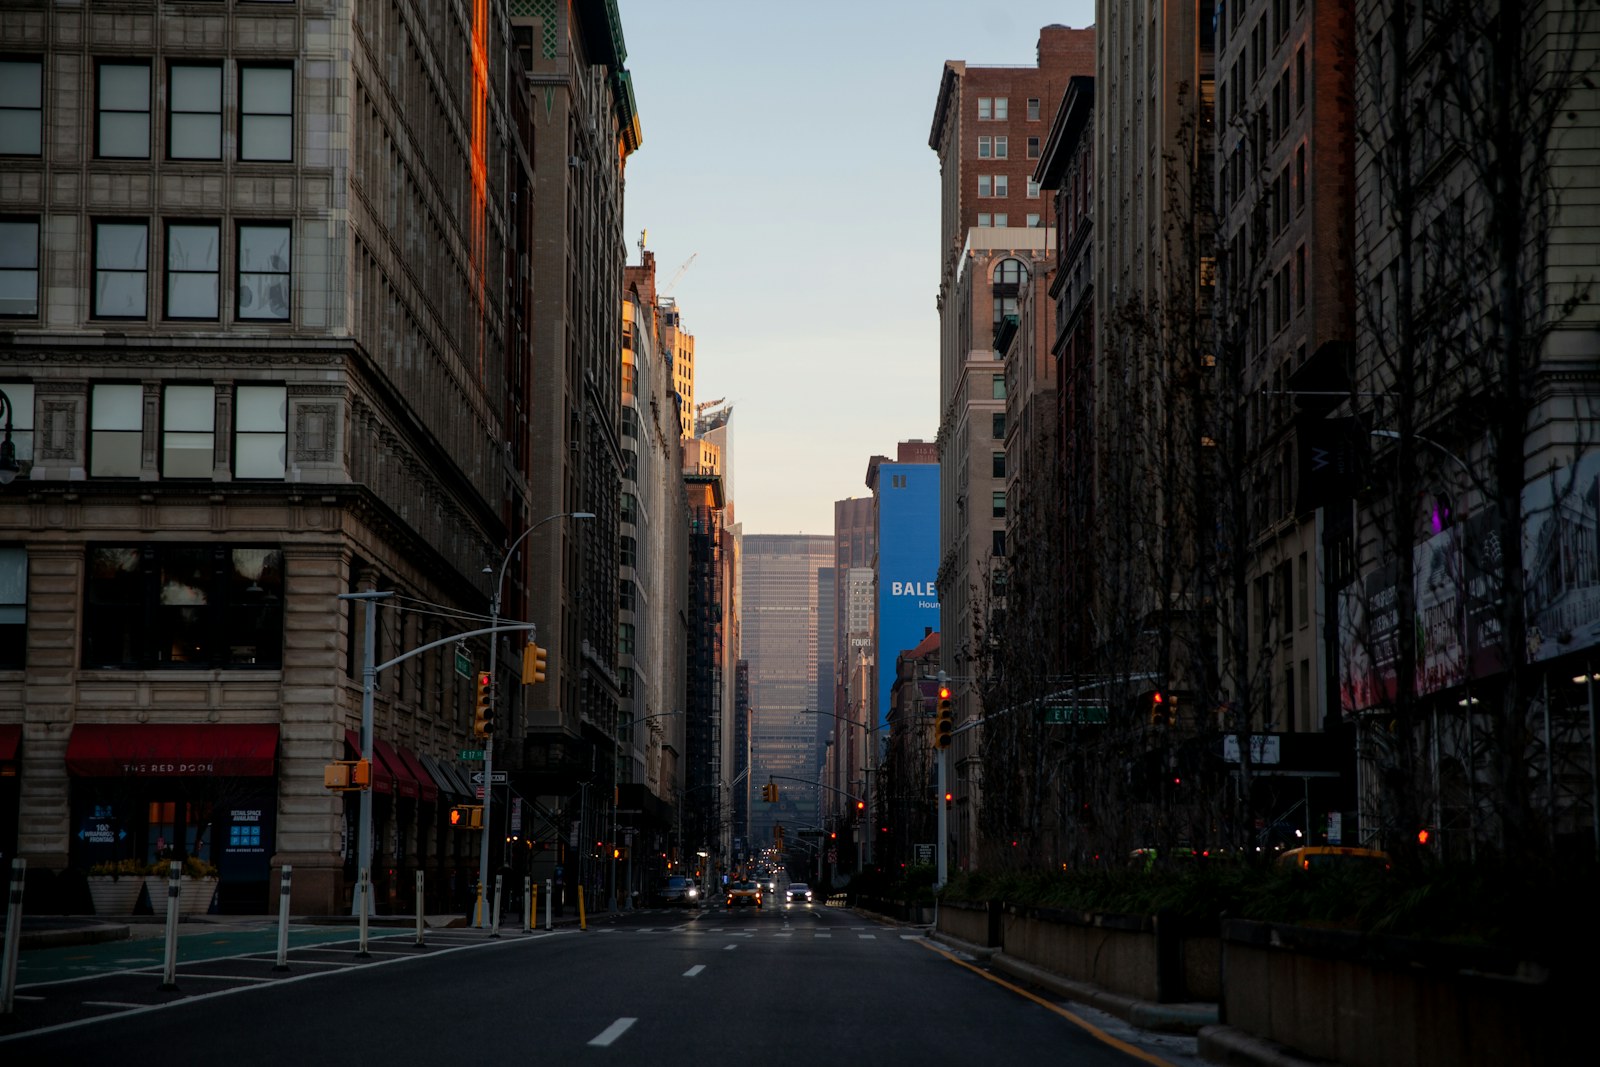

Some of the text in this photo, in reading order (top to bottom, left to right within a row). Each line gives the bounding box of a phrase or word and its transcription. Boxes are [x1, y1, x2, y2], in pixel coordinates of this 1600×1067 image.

[1311, 446, 1330, 472] W
[892, 581, 936, 596] BALE
[462, 750, 466, 759] E
[468, 750, 476, 759] 17
[122, 763, 213, 772] THE RED DOOR
